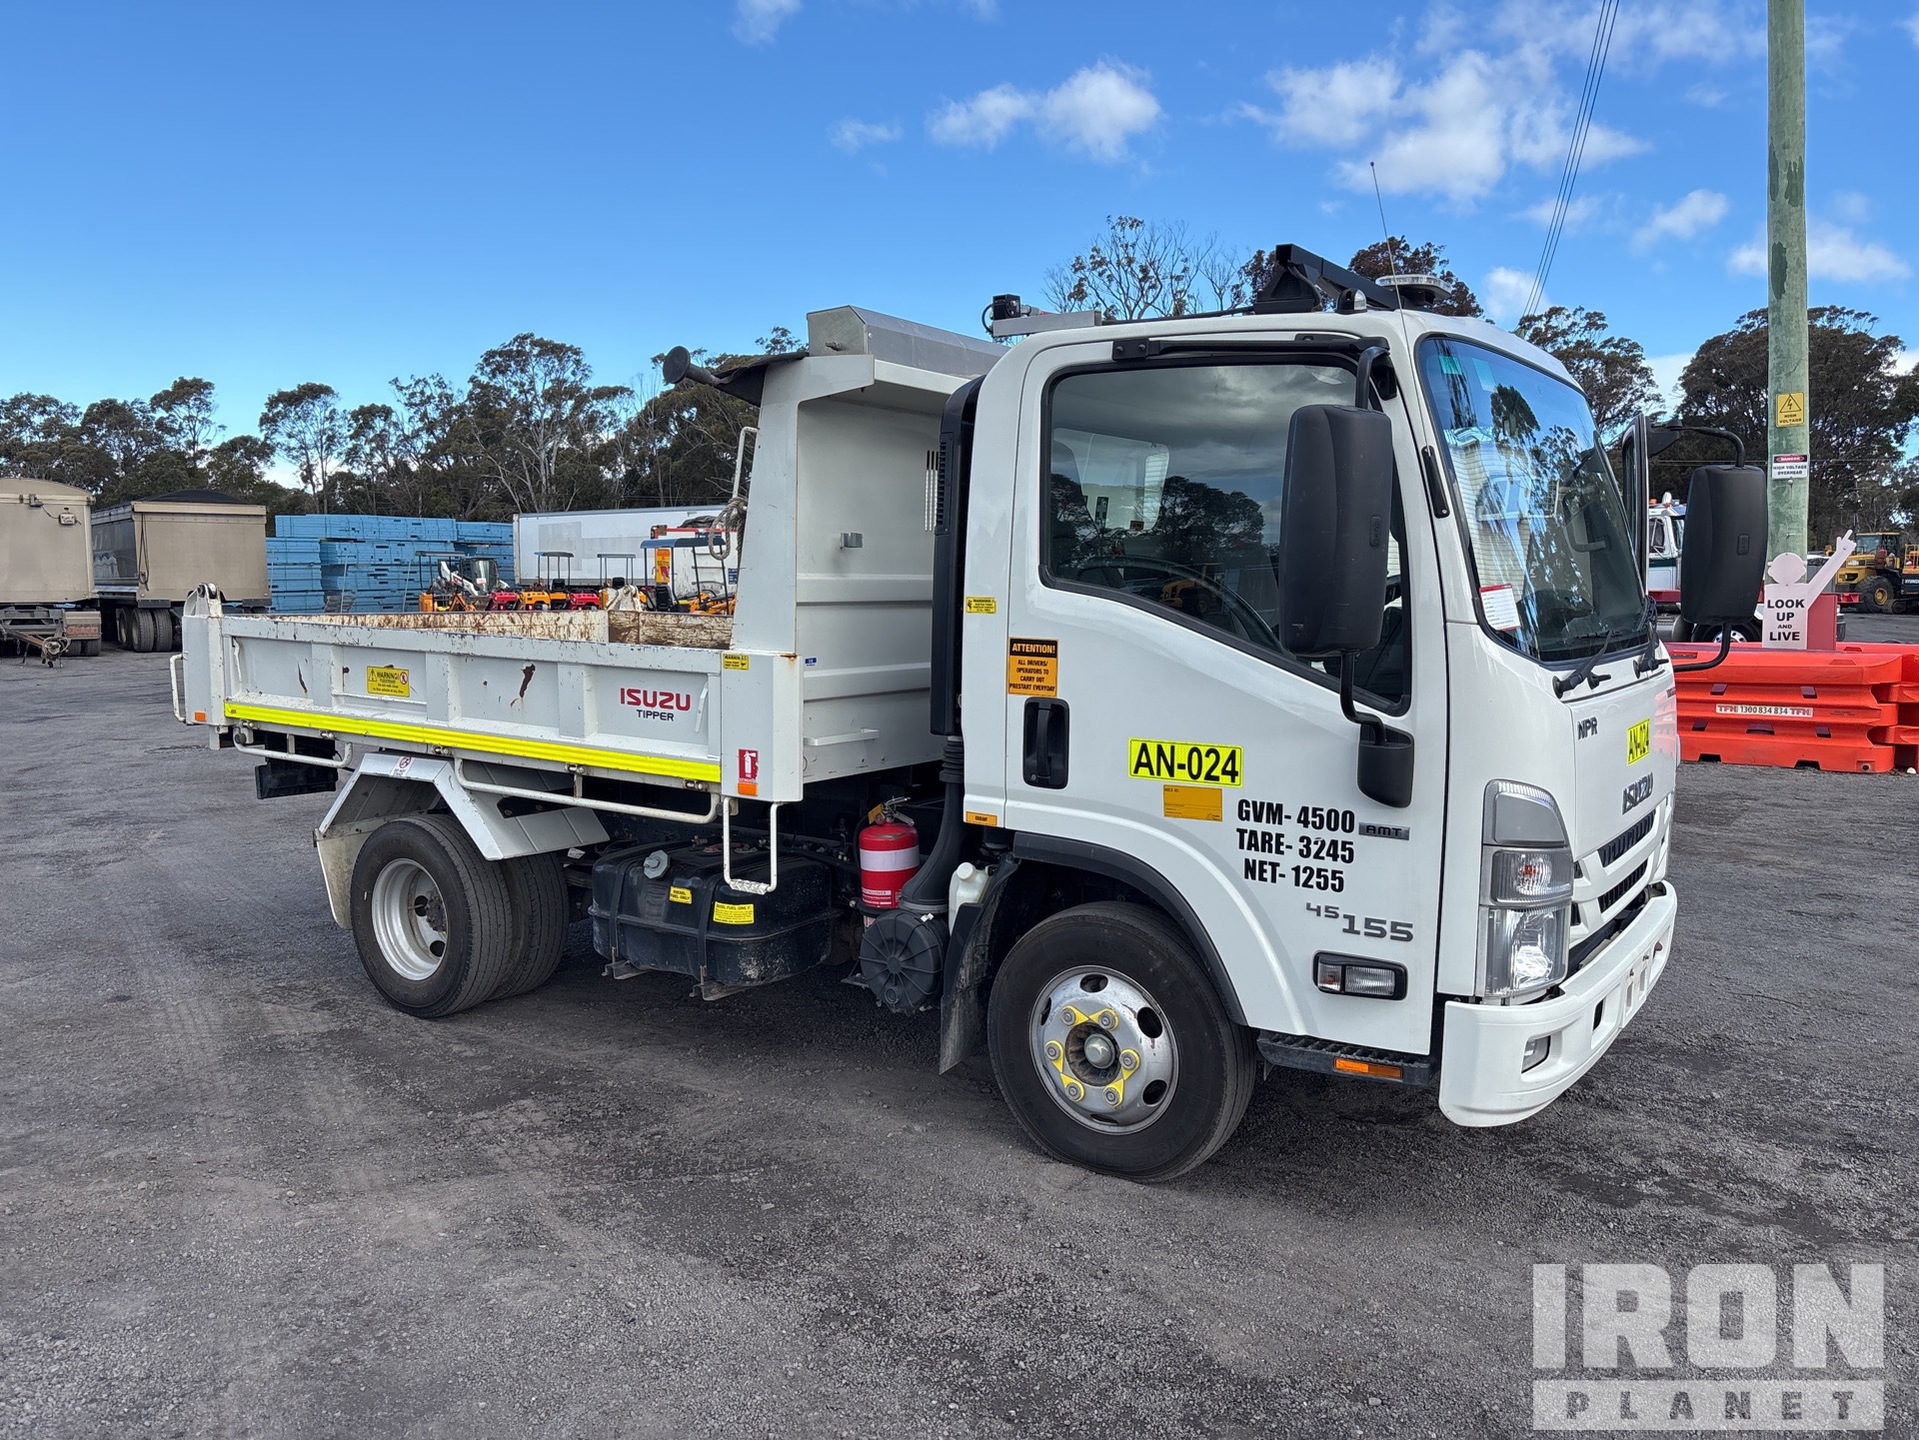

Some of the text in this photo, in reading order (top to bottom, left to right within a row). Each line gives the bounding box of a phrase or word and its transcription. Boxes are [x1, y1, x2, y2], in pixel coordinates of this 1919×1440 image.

[1767, 599, 1805, 609] LOOK
[1776, 612, 1795, 621] UP
[1769, 631, 1800, 641] LIVE
[1012, 643, 1056, 654] ATTENTION!
[377, 672, 399, 680] WARNING!
[620, 687, 691, 711] ISUZU
[636, 709, 674, 722] TIPPER
[1740, 706, 1758, 714] 1300
[1758, 706, 1772, 714] 834
[1577, 716, 1598, 740] NPR
[1133, 742, 1239, 783] AN-024
[1237, 799, 1355, 834] GVM- 4500
[1365, 825, 1403, 837] AMT
[1236, 828, 1354, 864] TARE- 3245
[1244, 858, 1345, 893] NET- 1255
[1342, 913, 1414, 942] 155
